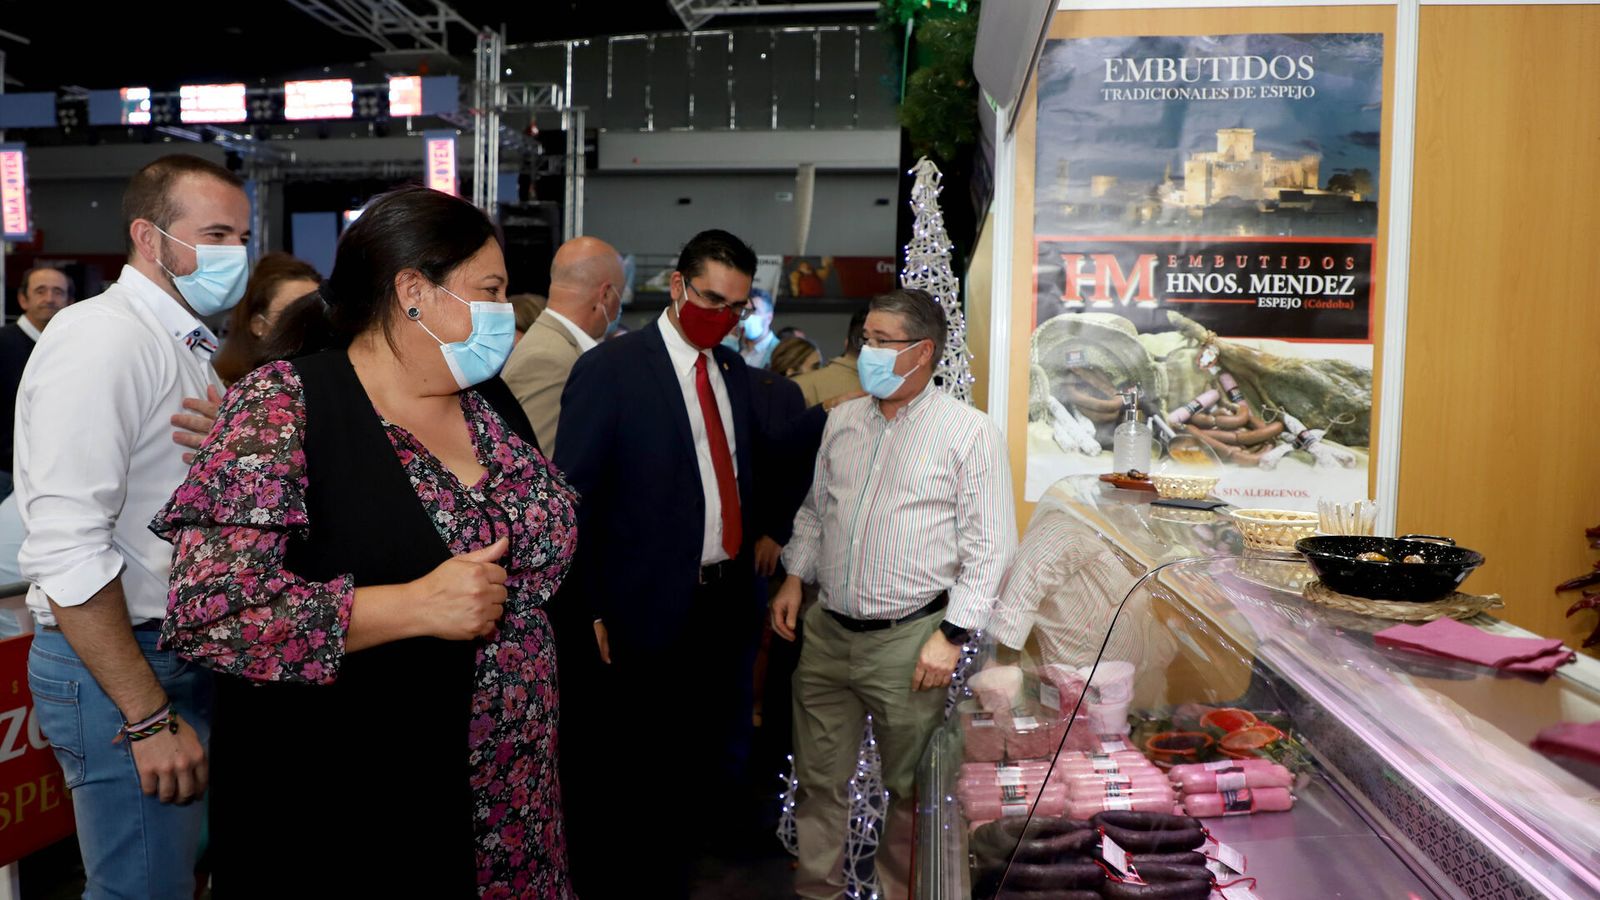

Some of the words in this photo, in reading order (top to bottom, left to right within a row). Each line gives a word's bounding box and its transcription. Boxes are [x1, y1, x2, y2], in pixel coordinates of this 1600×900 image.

[1103, 55, 1315, 83] EMBUTIDOS
[1101, 87, 1230, 101] TRADICIONALES
[1233, 86, 1257, 99] DE
[1260, 85, 1316, 100] ESPEJO
[1167, 254, 1355, 270] EMBUTIDOS
[1060, 253, 1159, 308] HM
[1166, 273, 1243, 294] HNOS.
[1249, 274, 1356, 296] MENDEZ
[1257, 297, 1302, 309] ESPEJO
[1303, 298, 1355, 310] (Córdoba)
[1223, 487, 1241, 497] SIN
